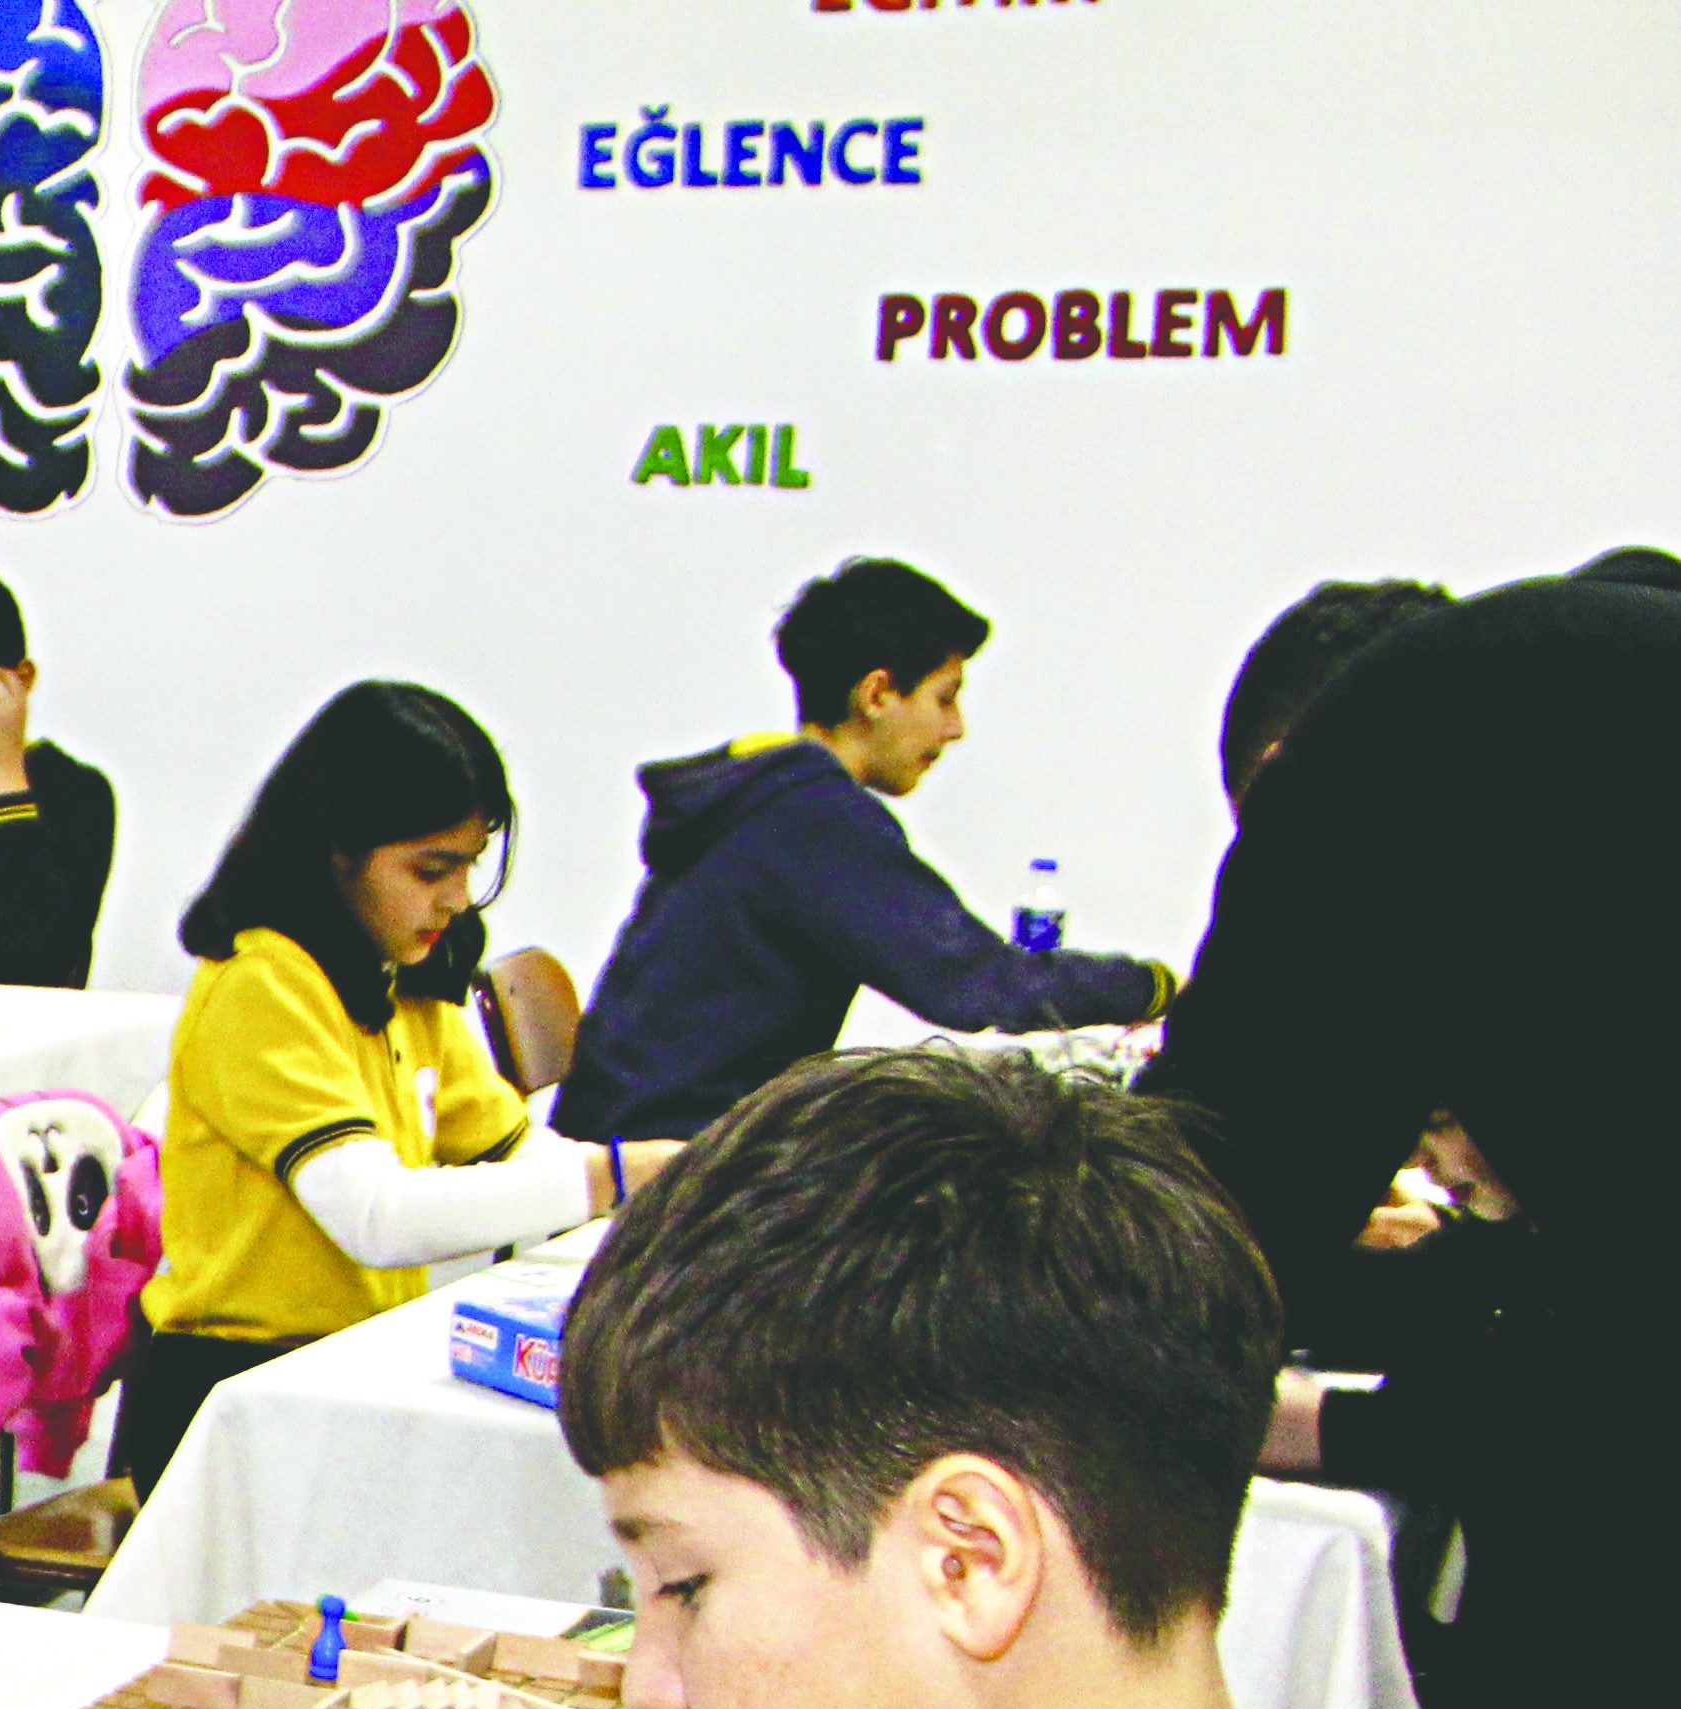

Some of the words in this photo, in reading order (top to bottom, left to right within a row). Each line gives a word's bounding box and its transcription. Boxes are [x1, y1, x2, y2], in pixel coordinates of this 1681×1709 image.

[578, 105, 926, 191] EĞLENCE
[876, 287, 1289, 362] PROBLEM
[633, 424, 812, 490] AKIL
